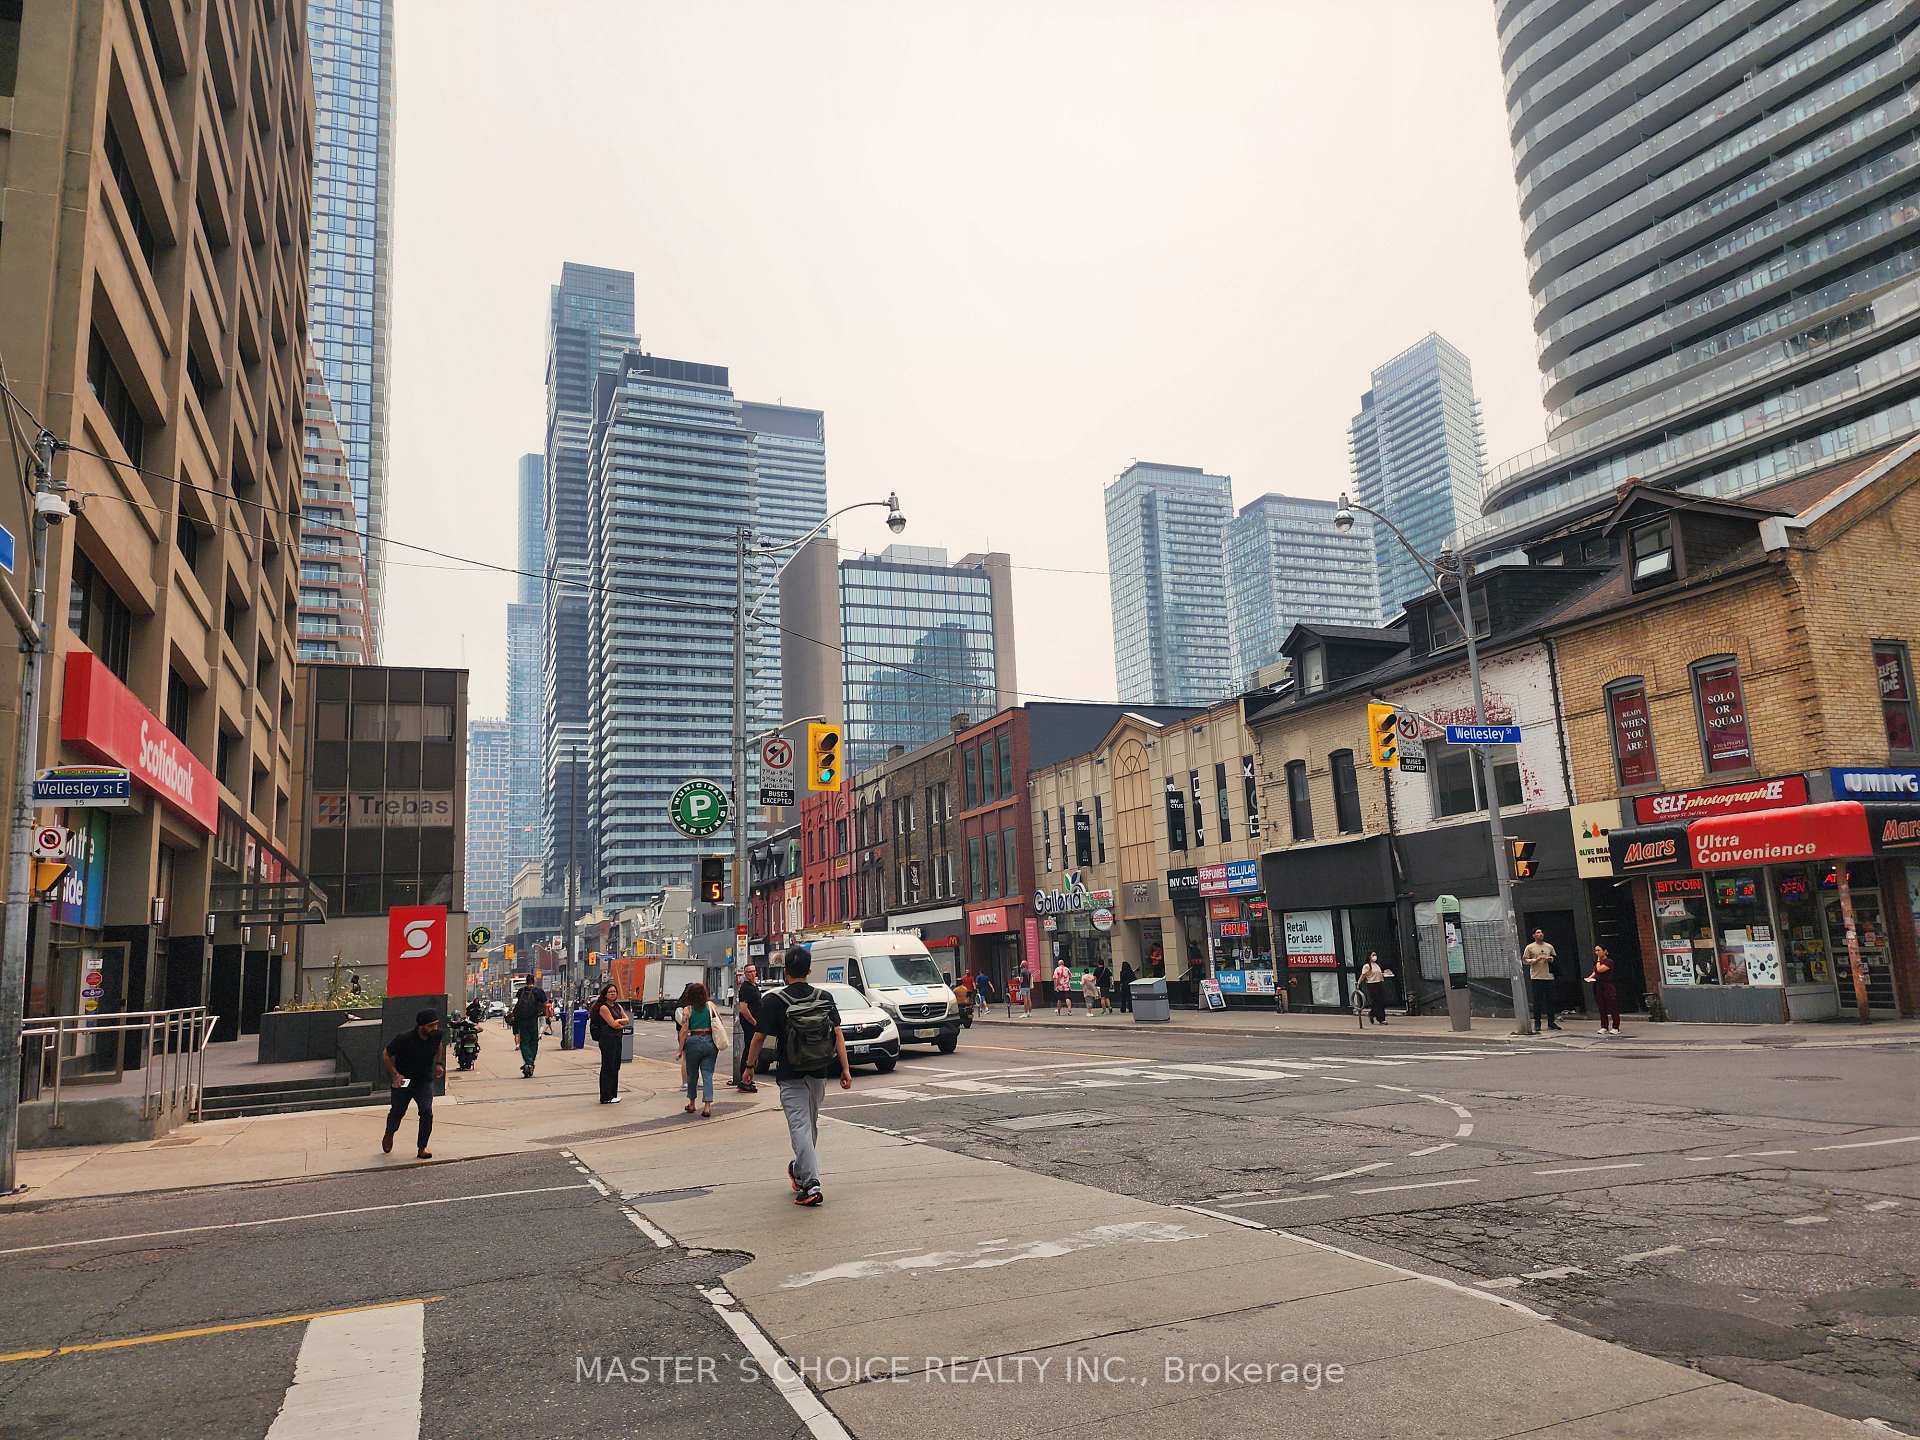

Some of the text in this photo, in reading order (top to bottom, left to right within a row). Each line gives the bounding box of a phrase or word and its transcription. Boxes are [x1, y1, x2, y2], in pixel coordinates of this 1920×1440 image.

[1707, 691, 1735, 704] SOLO
[1622, 709, 1641, 718] READY
[1715, 705, 1730, 714] OR
[1620, 717, 1647, 729] WHEN
[1708, 714, 1743, 728] SQUAD
[1454, 727, 1504, 742] Wellesley
[1625, 729, 1644, 740] YOU
[139, 719, 194, 805] Scotiabank
[37, 782, 124, 797] Wellesley St E
[674, 783, 723, 805] MUNICIPAL
[358, 796, 449, 814] Trebas
[689, 795, 712, 817] P
[674, 810, 726, 835] PARKING
[1696, 835, 1739, 849] Ultra
[1579, 848, 1595, 856] OLIVE
[1624, 839, 1676, 863] Mars
[1697, 841, 1816, 864] Convenience
[1200, 867, 1226, 880] PERFUMES
[1228, 863, 1256, 877] CELLULAR
[712, 883, 720, 899] 5
[1657, 879, 1704, 893] BITCOIN
[1034, 888, 1083, 915] Galleria
[1286, 920, 1308, 932] Retail
[1287, 934, 1322, 944] For Lease
[1219, 973, 1240, 986] lucky
